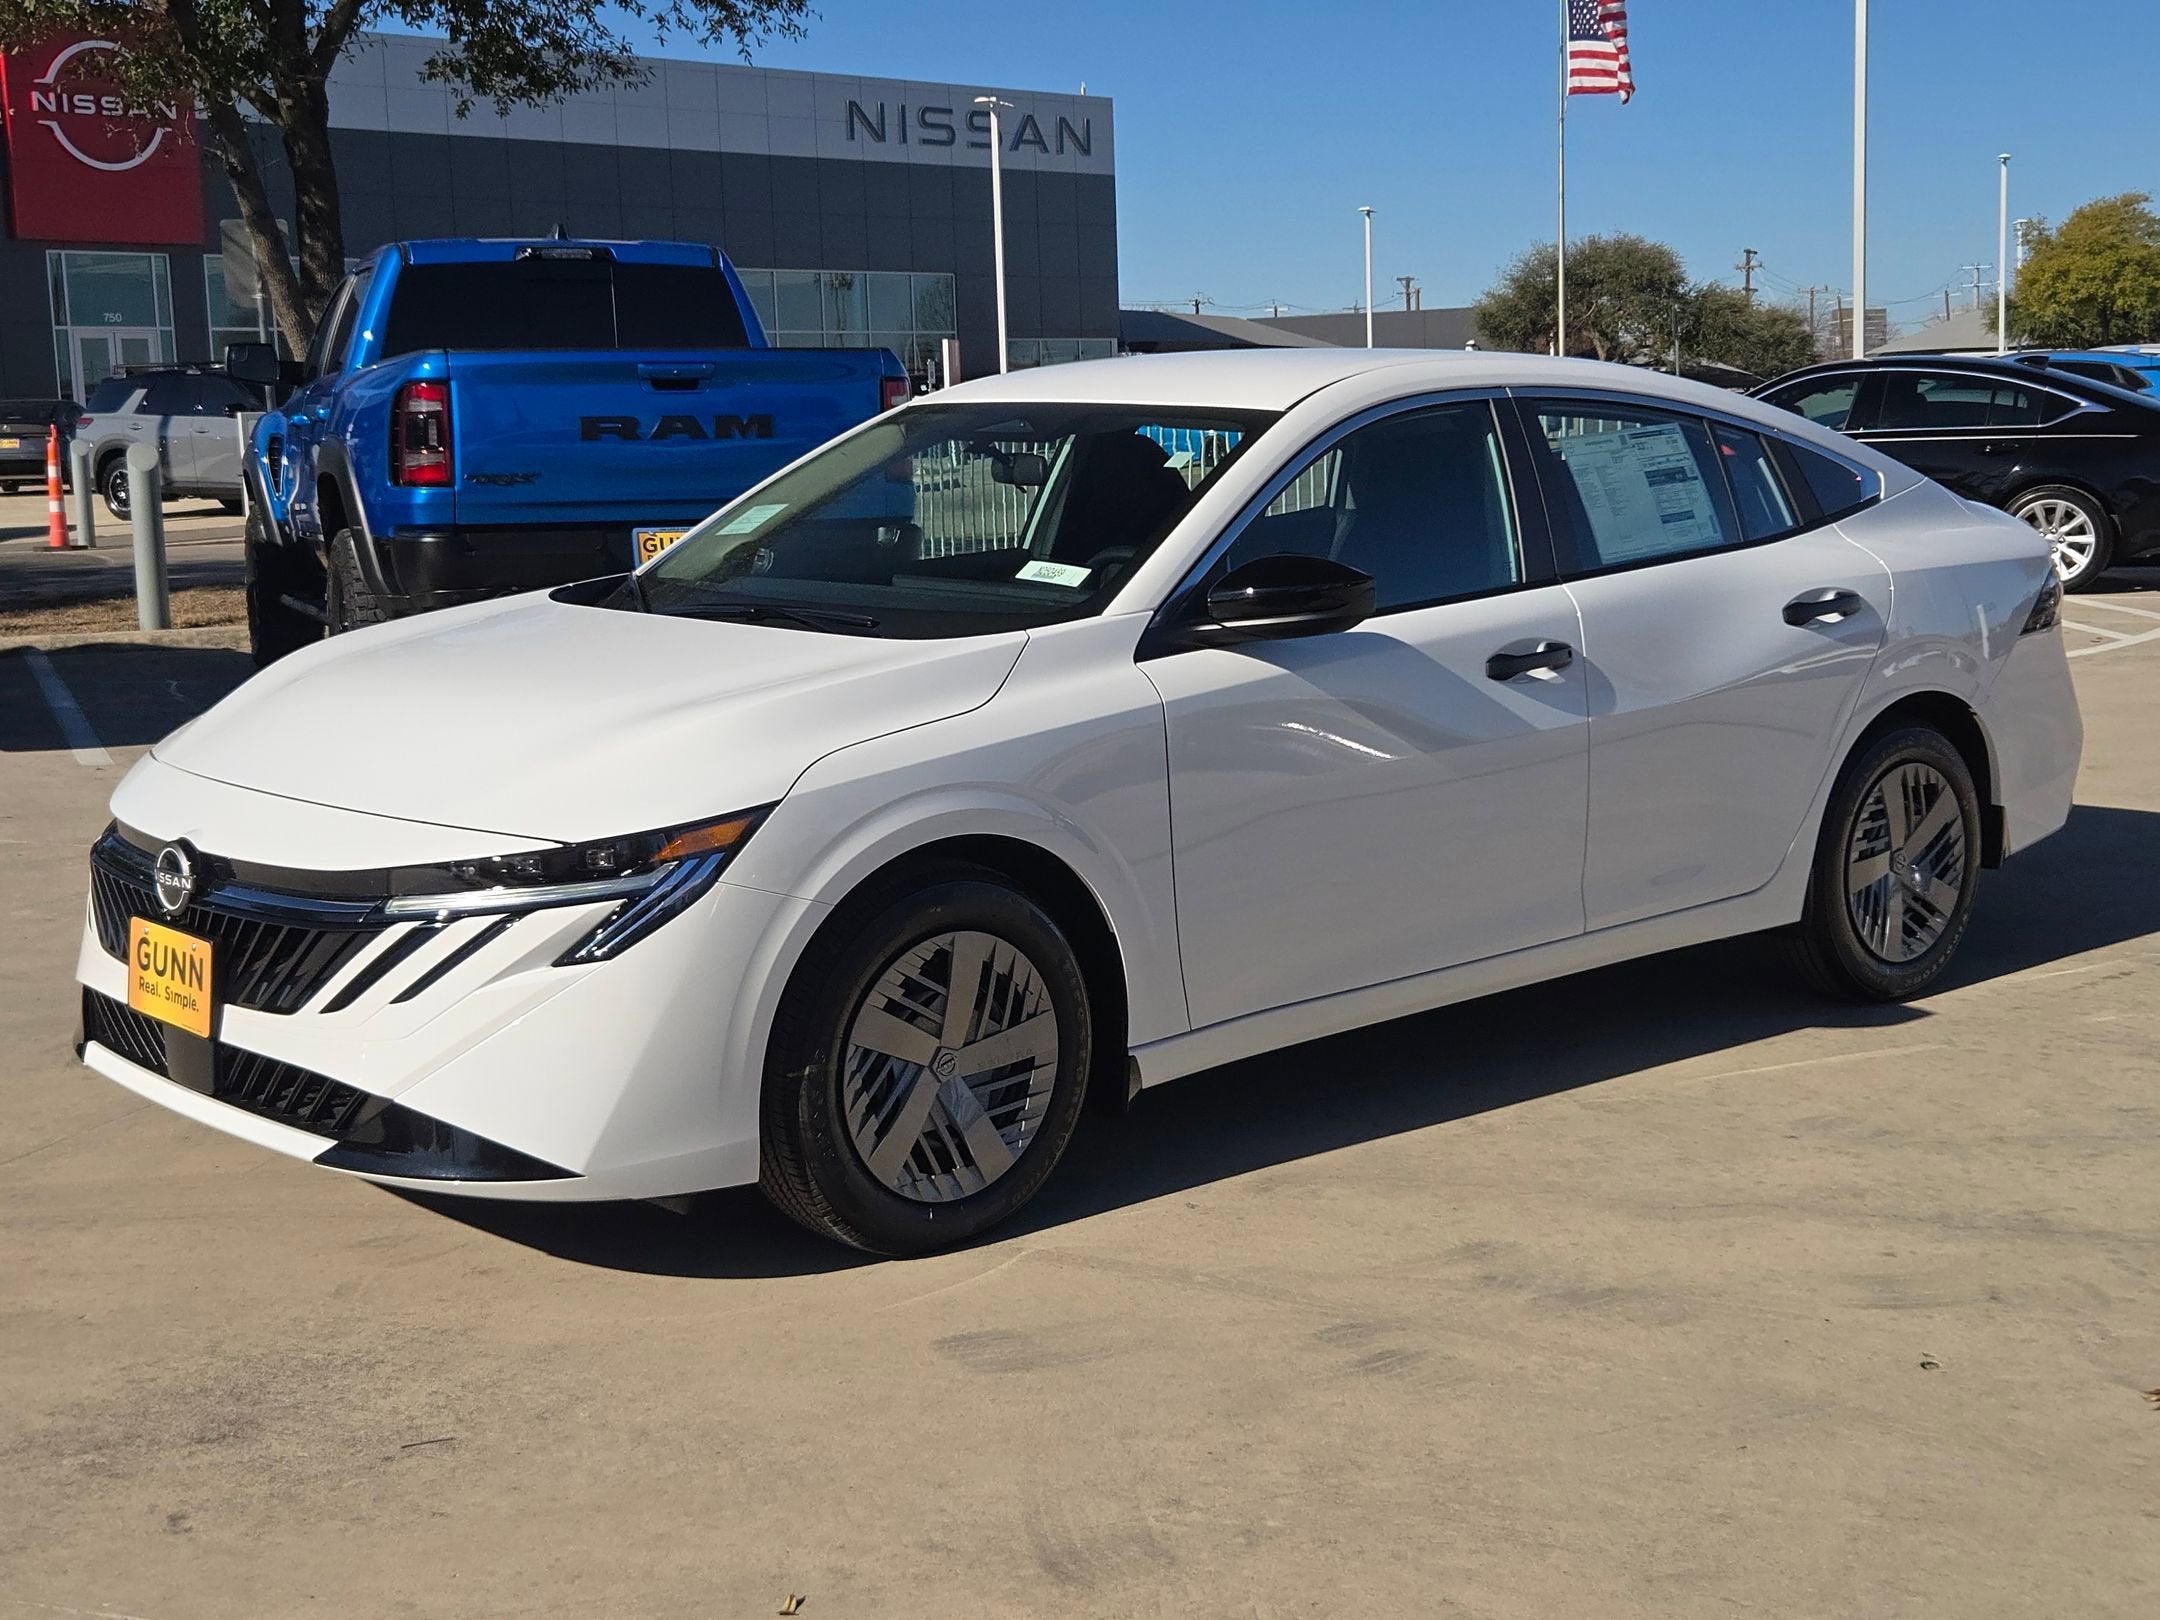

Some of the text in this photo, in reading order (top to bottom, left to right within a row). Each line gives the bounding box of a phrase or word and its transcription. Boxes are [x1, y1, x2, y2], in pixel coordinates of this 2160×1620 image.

[30, 91, 177, 120] NISSAN
[846, 100, 1093, 157] NISSAN
[103, 312, 122, 322] 750
[580, 415, 773, 441] RAM
[643, 537, 681, 553] GU
[159, 872, 191, 889] SSAN
[137, 936, 204, 992] GUNN
[139, 976, 199, 1012] Real. Simple.
